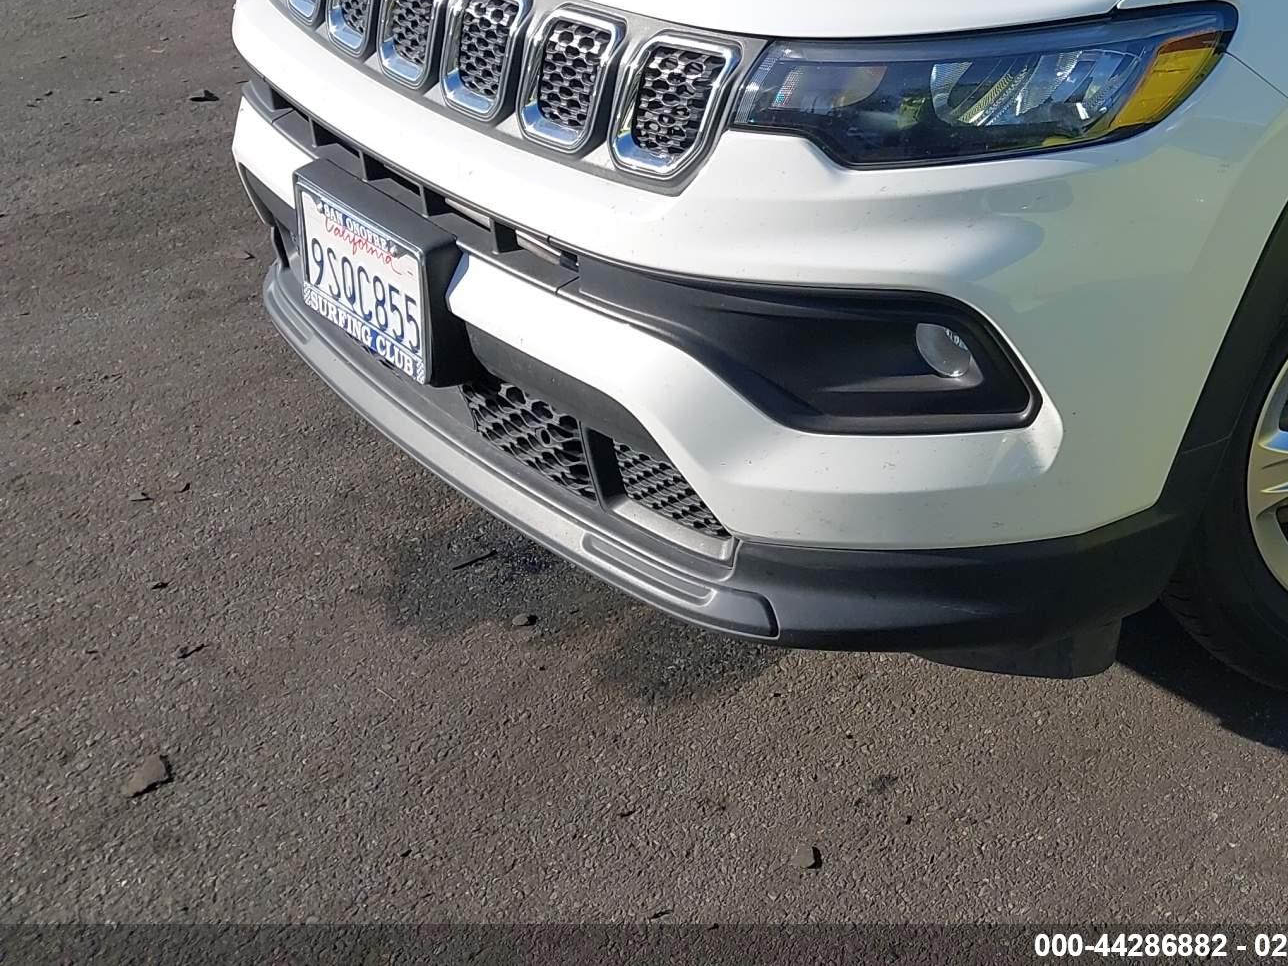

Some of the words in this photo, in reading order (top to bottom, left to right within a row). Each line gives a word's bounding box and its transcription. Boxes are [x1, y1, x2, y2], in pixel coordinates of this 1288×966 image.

[323, 203, 344, 226] SAN
[310, 293, 373, 348] SURFING
[375, 333, 415, 377] CLUB
[311, 237, 421, 354] 9SQC855
